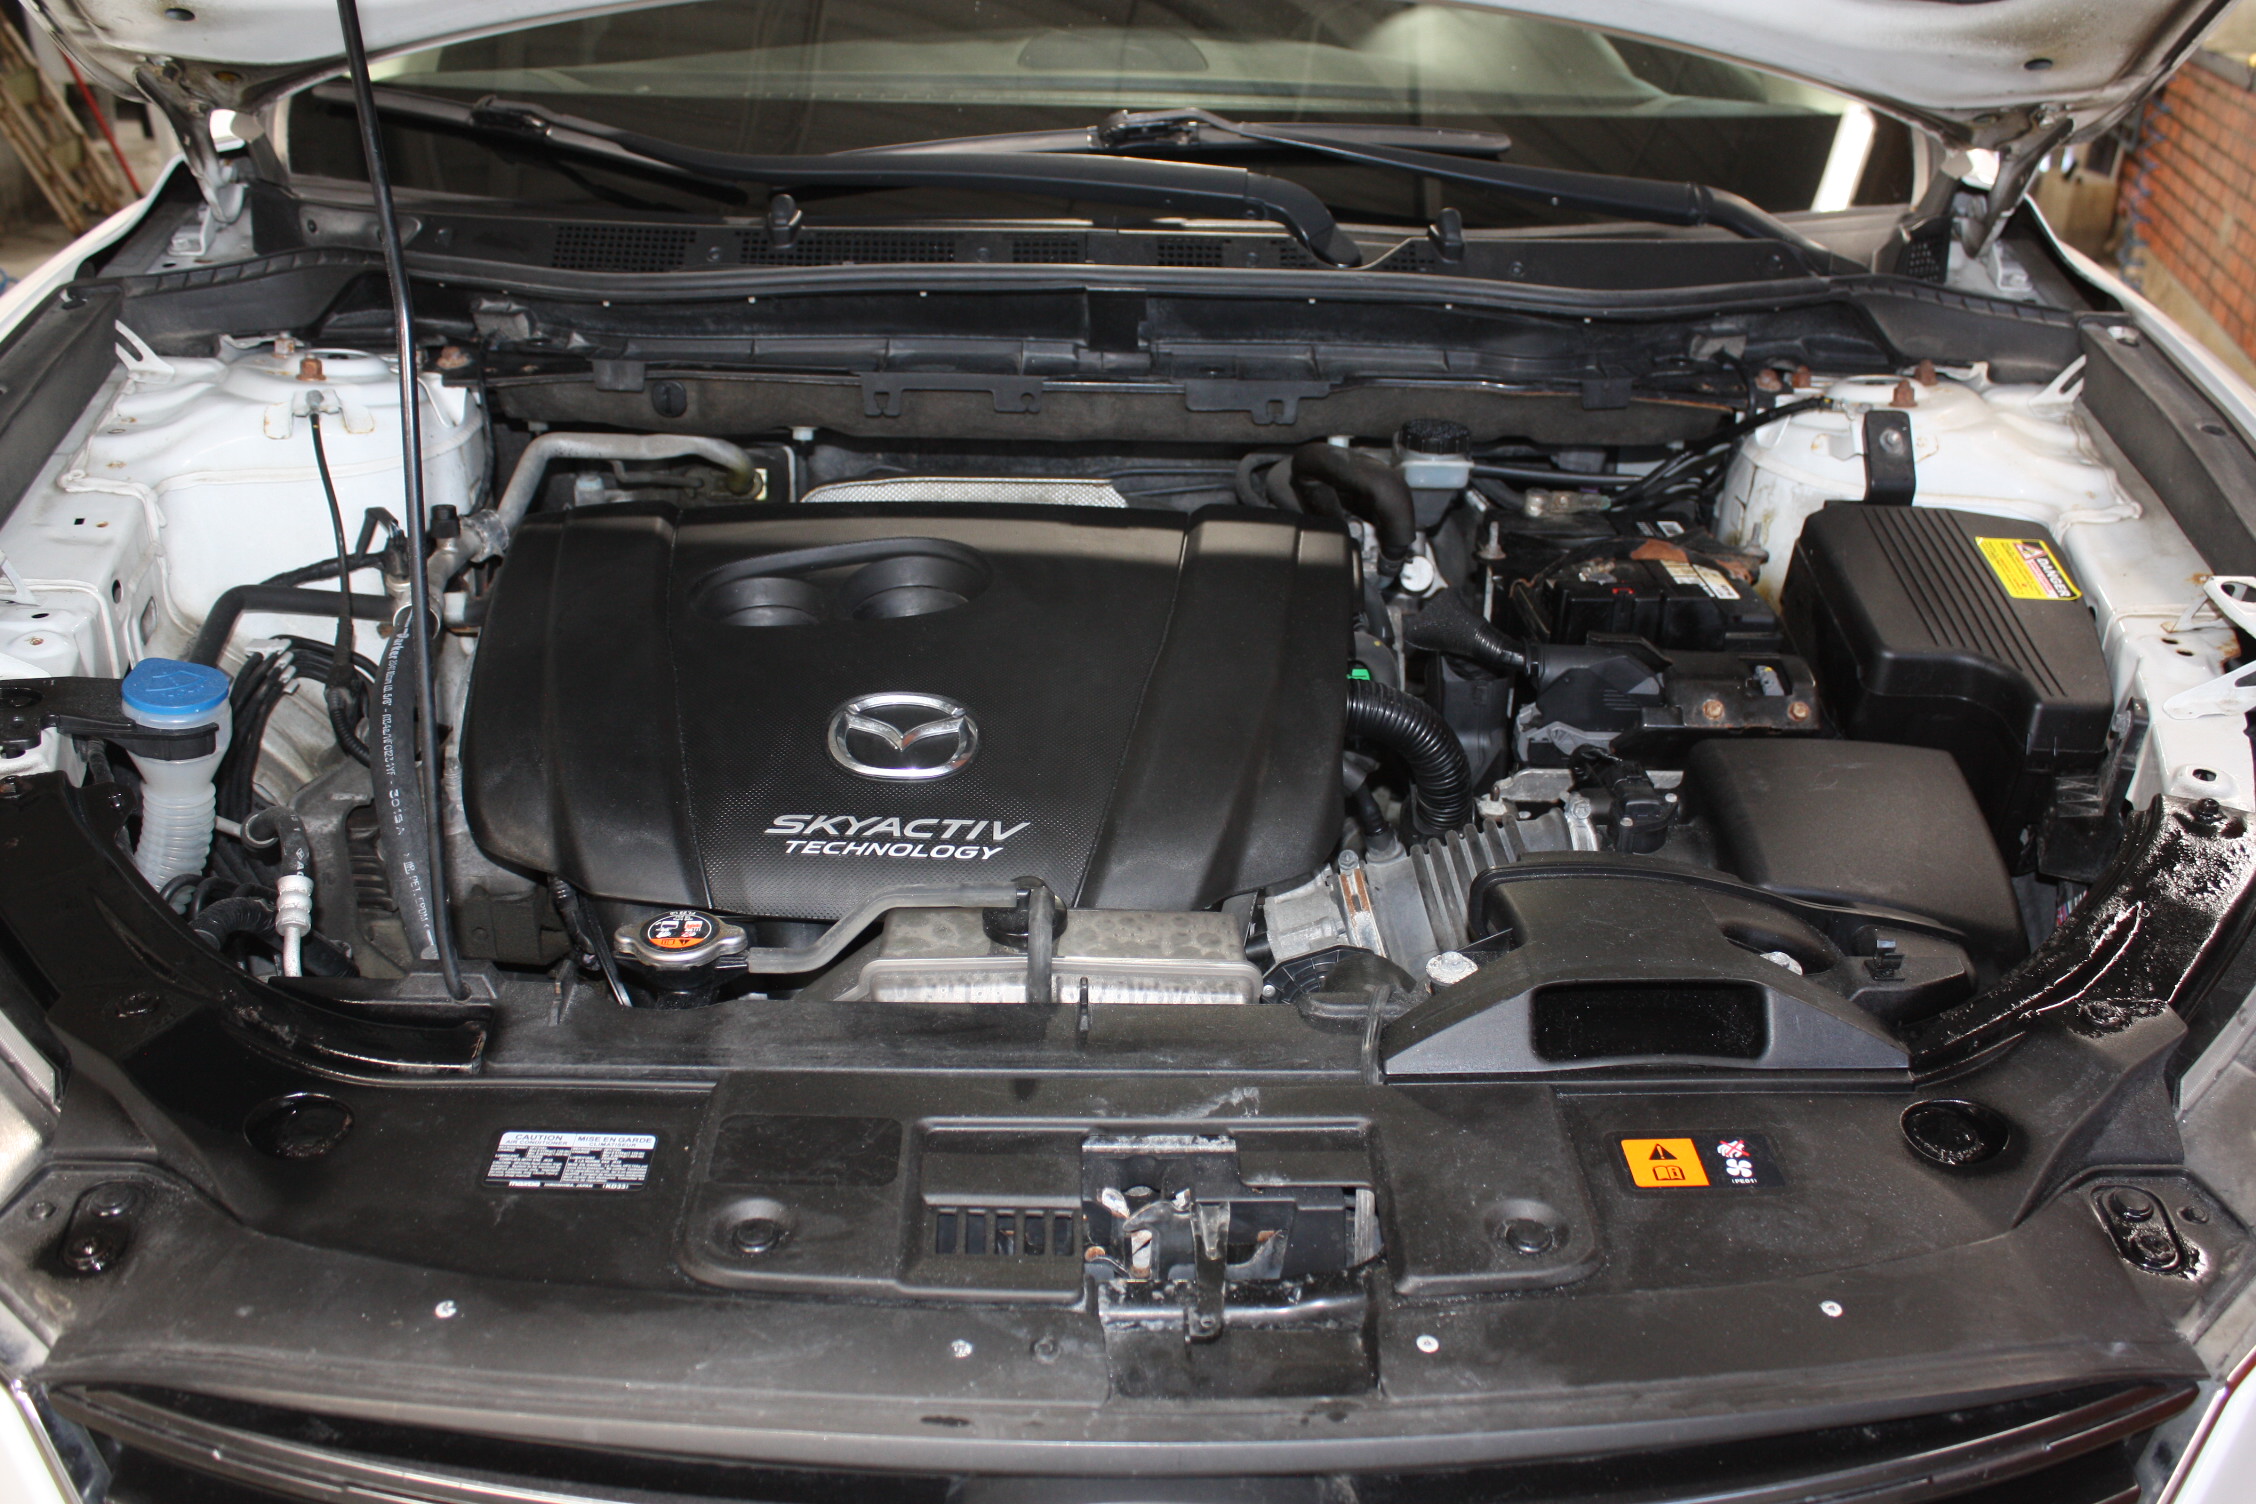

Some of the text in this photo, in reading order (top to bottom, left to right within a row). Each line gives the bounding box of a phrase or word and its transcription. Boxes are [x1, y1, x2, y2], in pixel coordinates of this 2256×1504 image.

[2037, 557, 2071, 597] DANGER
[388, 633, 409, 659] Parker
[763, 814, 1031, 841] SKYACTIV
[785, 840, 1004, 860] TECHNOLOGY
